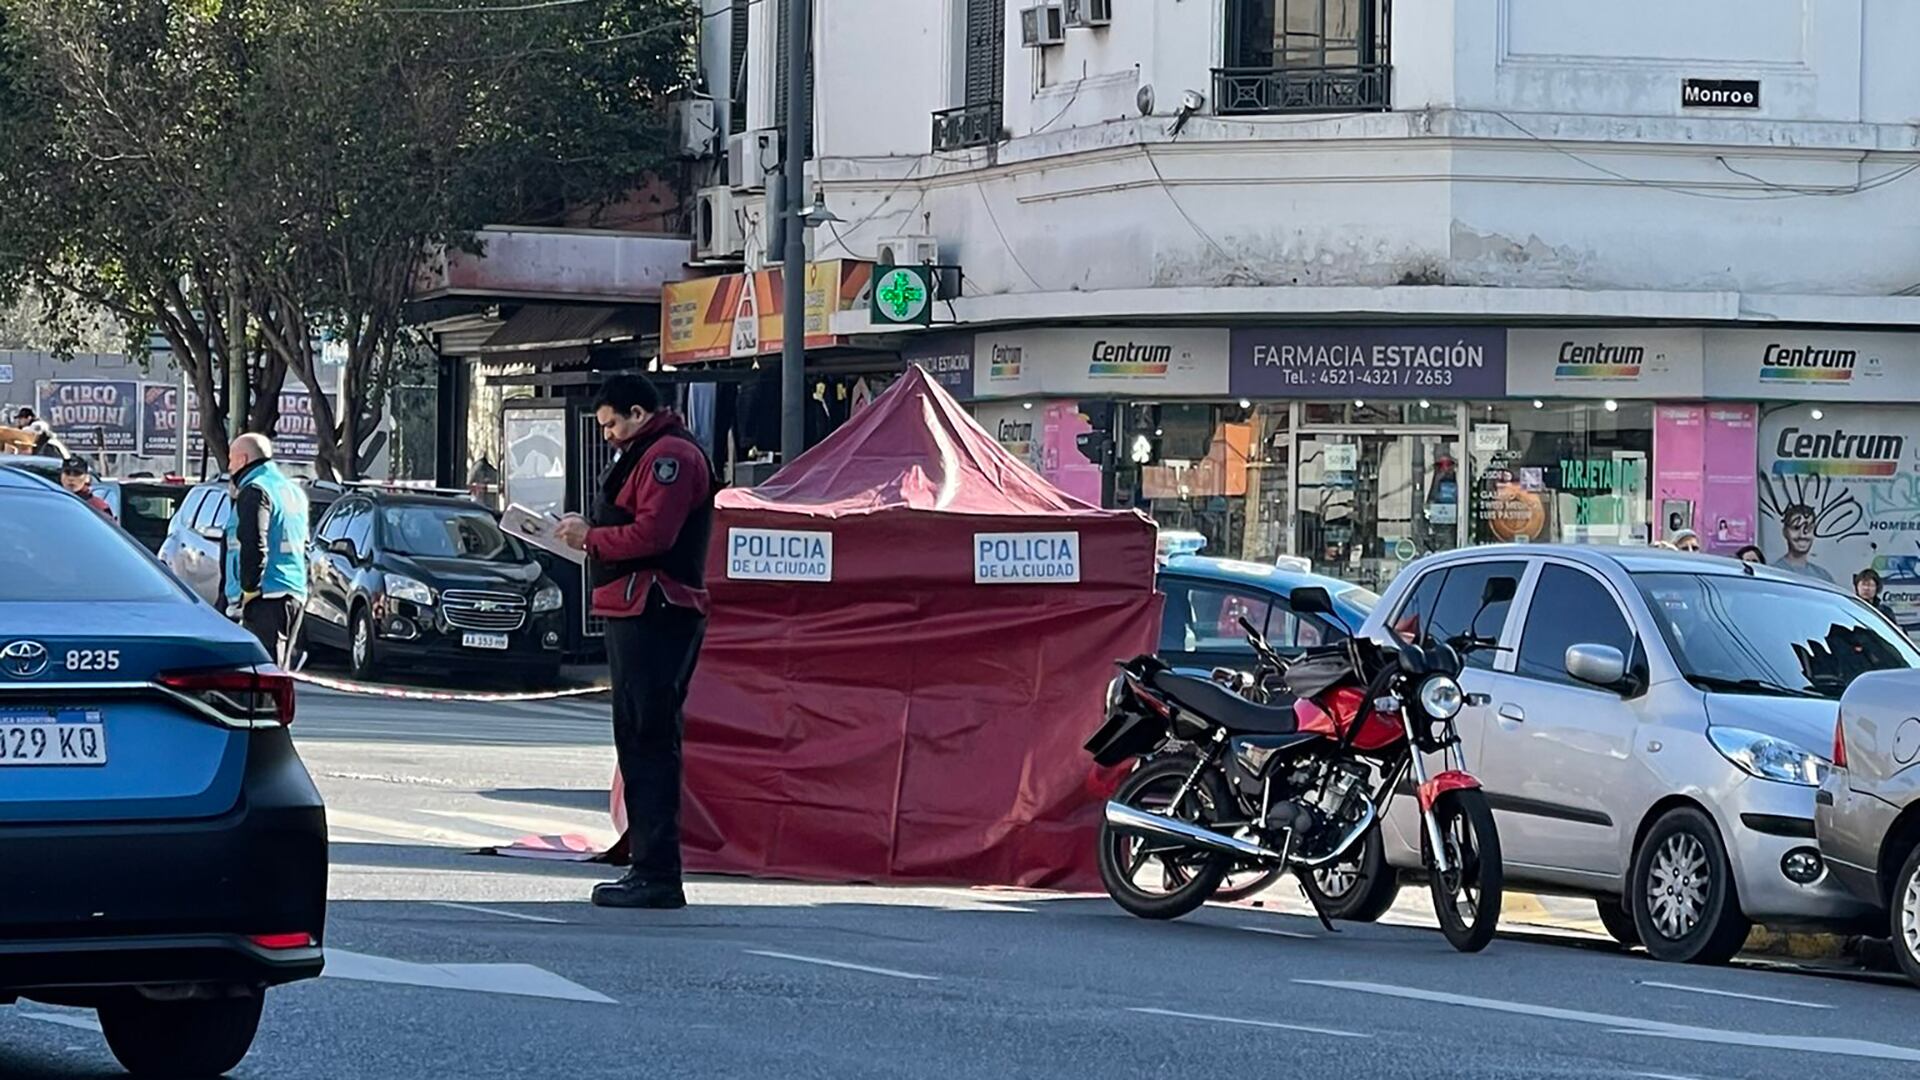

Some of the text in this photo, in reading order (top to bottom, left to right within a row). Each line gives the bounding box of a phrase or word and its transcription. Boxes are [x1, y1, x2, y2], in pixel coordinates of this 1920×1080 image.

[1685, 86, 1754, 103] Monroe
[992, 344, 1022, 364] Centrum
[1092, 341, 1171, 363] Centrum
[1254, 340, 1483, 367] FARMACIA ESTACIÓN
[1558, 341, 1644, 364] Centrum
[1763, 344, 1857, 368] Centrum
[1283, 370, 1308, 384] Tel.
[1320, 369, 1398, 384] 4521-4321
[1415, 370, 1453, 385] 2653
[60, 385, 117, 406] CIRCO
[51, 405, 125, 426] HOUDINI
[998, 418, 1032, 442] Centrum
[1776, 427, 1904, 459] Centrum
[1560, 460, 1621, 490] TARJETA
[734, 535, 824, 558] POLICIA
[980, 539, 1072, 561] POLICIA
[733, 560, 826, 575] DE LA CIUDAD
[980, 563, 1074, 577] DE LA CIUDAD
[66, 650, 120, 670] 8235
[59, 727, 97, 758] KQ
